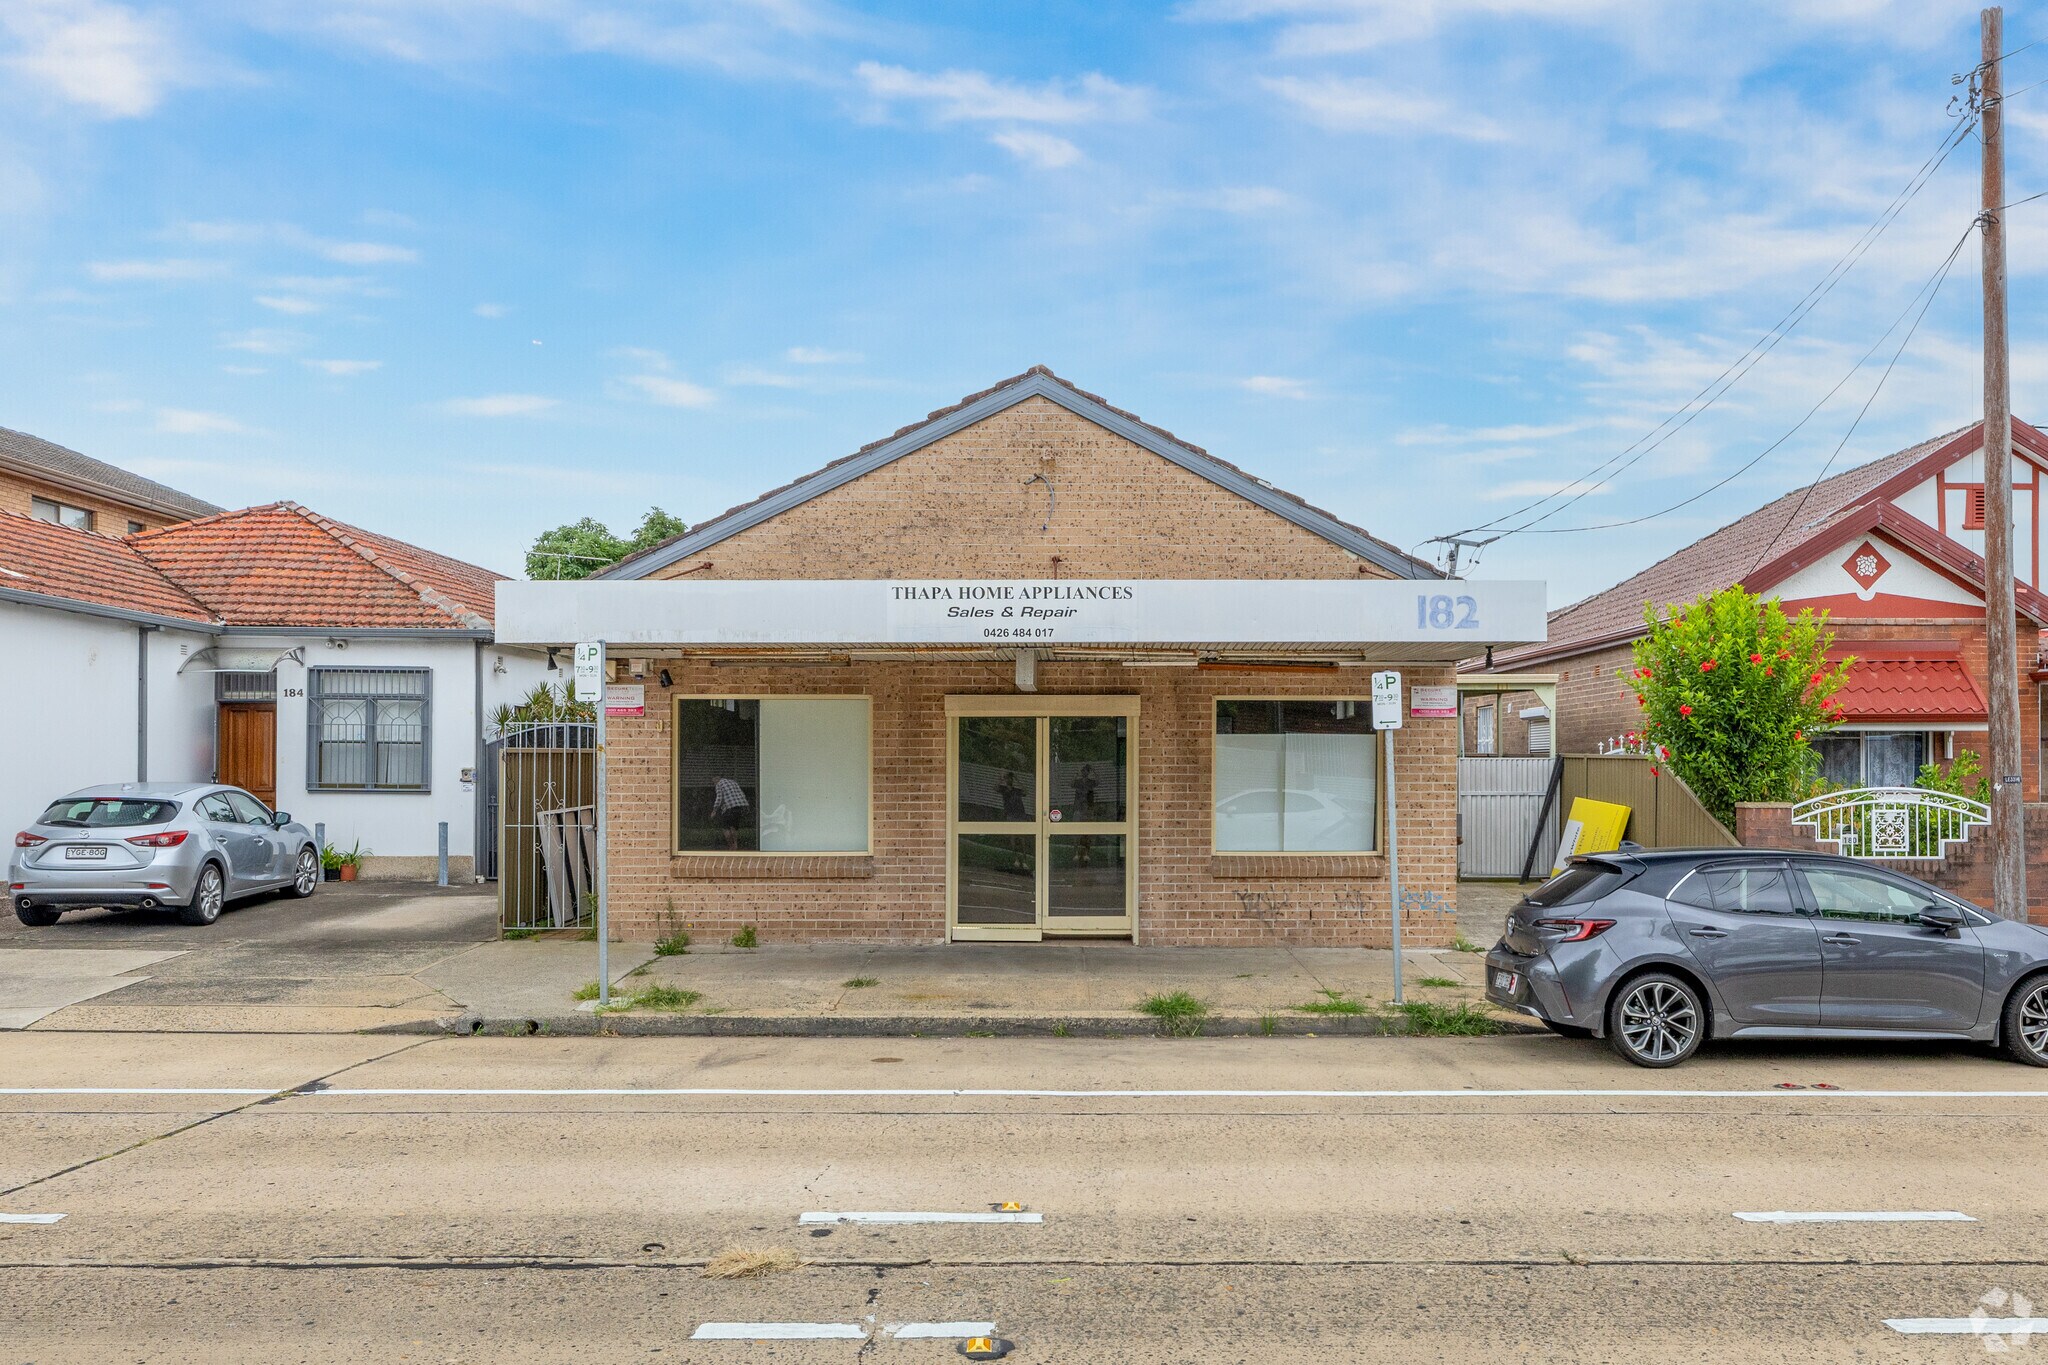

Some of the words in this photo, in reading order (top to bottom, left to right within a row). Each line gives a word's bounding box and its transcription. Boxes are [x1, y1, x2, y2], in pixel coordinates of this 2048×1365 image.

[892, 586, 952, 600] THAPA
[958, 586, 1014, 600] HOME
[1018, 586, 1133, 600] APPLIANCES
[947, 606, 994, 618] Sales
[1001, 606, 1014, 618] &
[1021, 606, 1077, 620] Repair
[1417, 595, 1480, 630] 182
[983, 628, 1009, 638] 0426
[1012, 628, 1032, 638] 484
[1035, 628, 1054, 638] 017
[588, 647, 598, 661] P
[1386, 676, 1396, 690] P
[283, 688, 304, 698] 184
